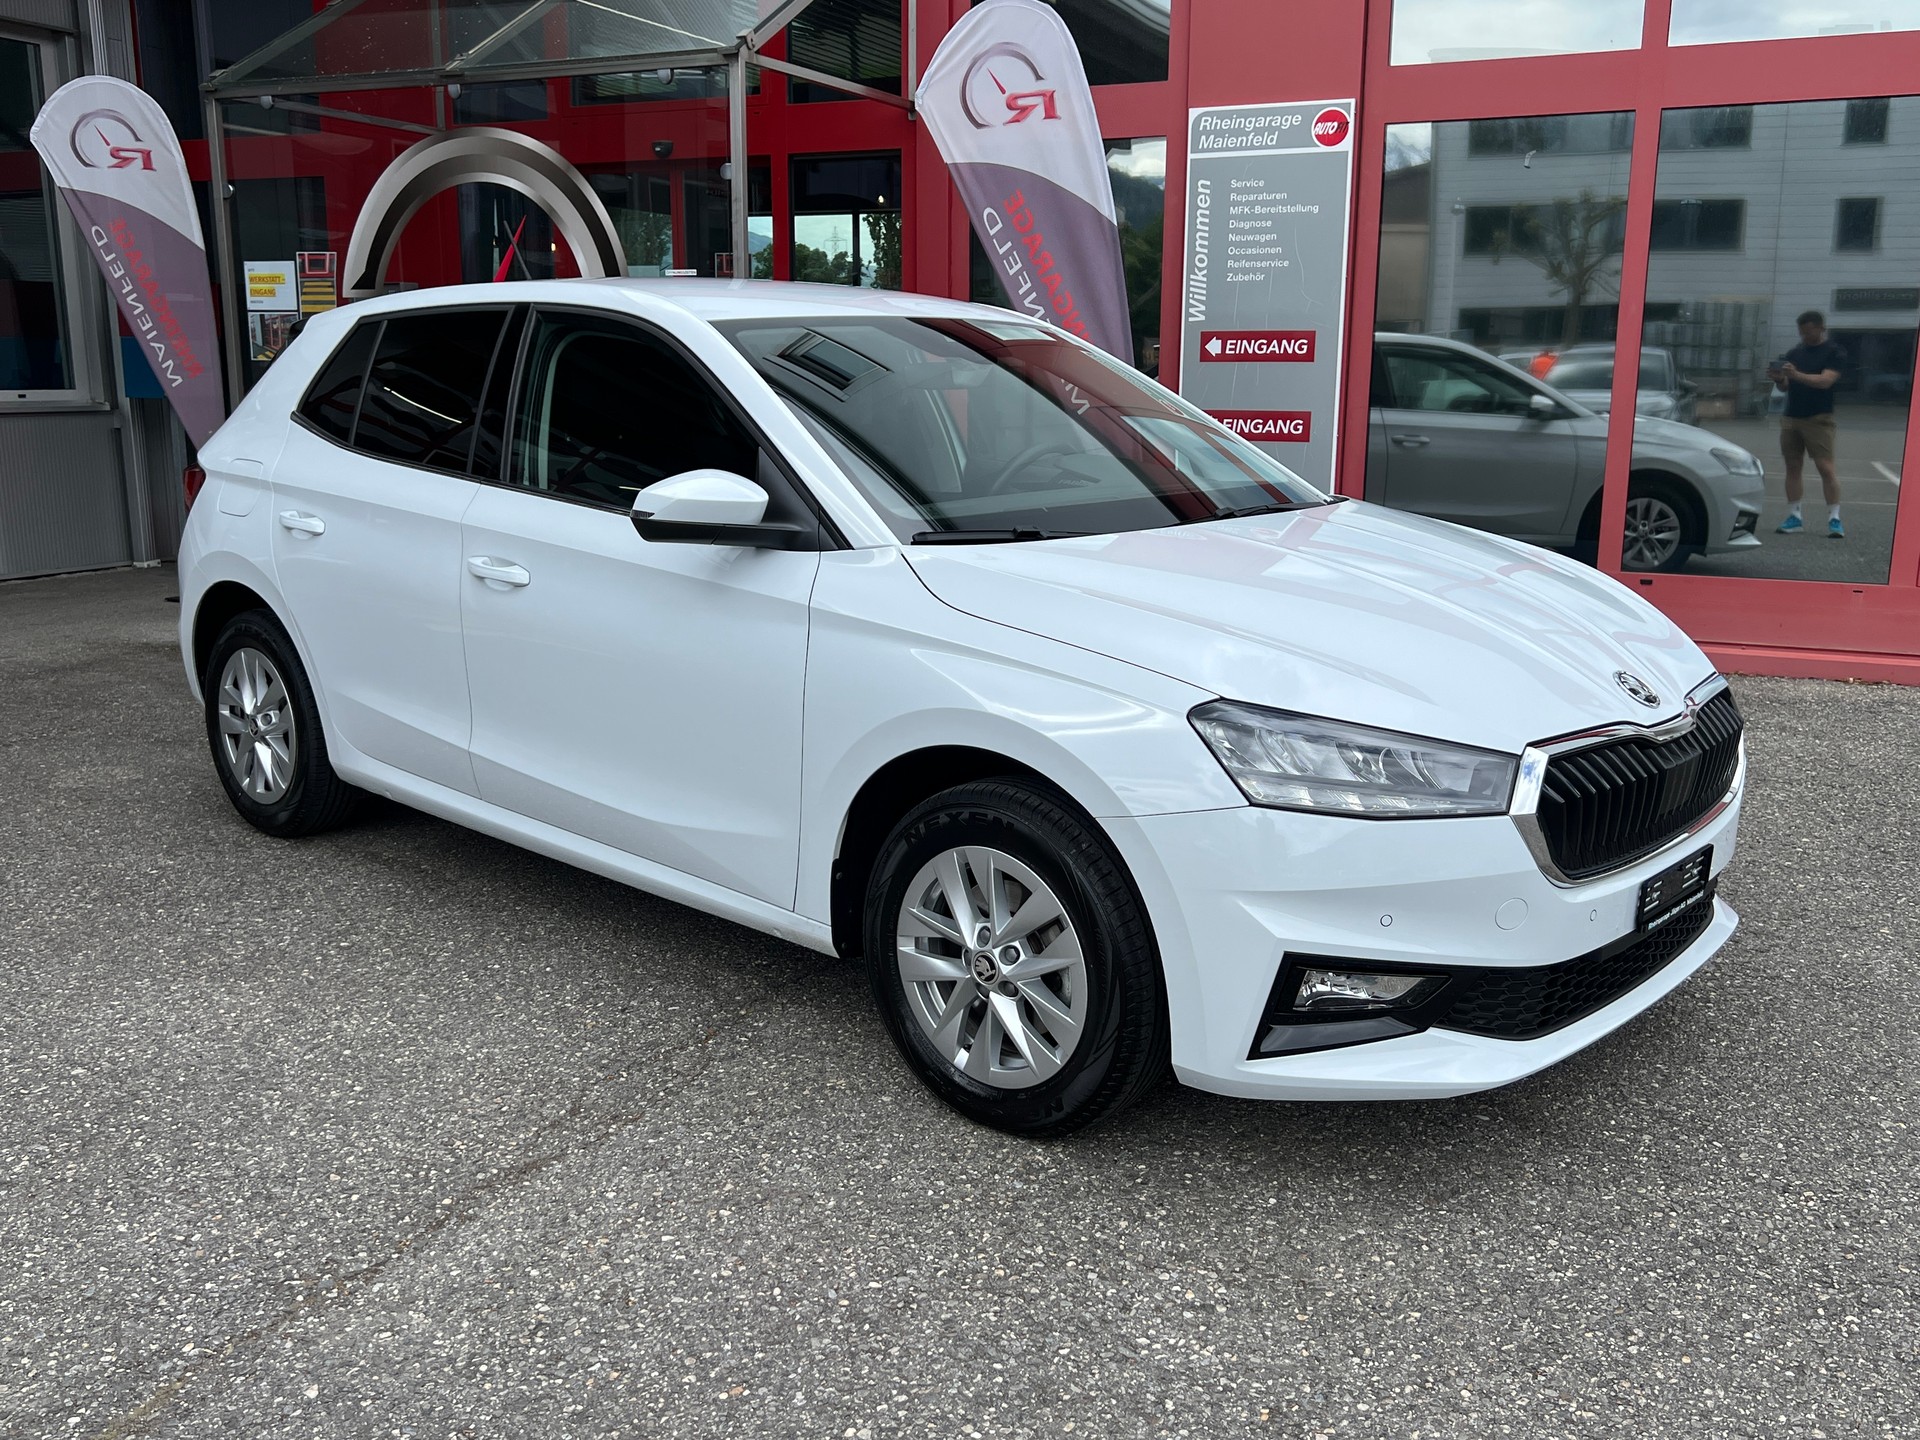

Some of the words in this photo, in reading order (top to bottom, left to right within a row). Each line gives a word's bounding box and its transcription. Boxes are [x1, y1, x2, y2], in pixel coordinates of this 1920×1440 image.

[1199, 114, 1302, 131] Rheingarage
[1199, 131, 1279, 149] Maienfeld
[1230, 178, 1265, 188] Service
[1230, 192, 1288, 203] Reparaturen
[1229, 204, 1320, 215] MFK-Bereitstellung
[1229, 219, 1272, 229] Diagnose
[1228, 233, 1277, 243] Neuwagen
[1188, 179, 1211, 322] Willkommen
[1227, 245, 1282, 255] Occasionen
[1227, 258, 1290, 268] Reifenservice
[1226, 272, 1266, 282] Zubehör
[250, 288, 277, 296] EINGANG
[1225, 339, 1308, 354] EINGANG
[903, 810, 1015, 849] NEXEN
